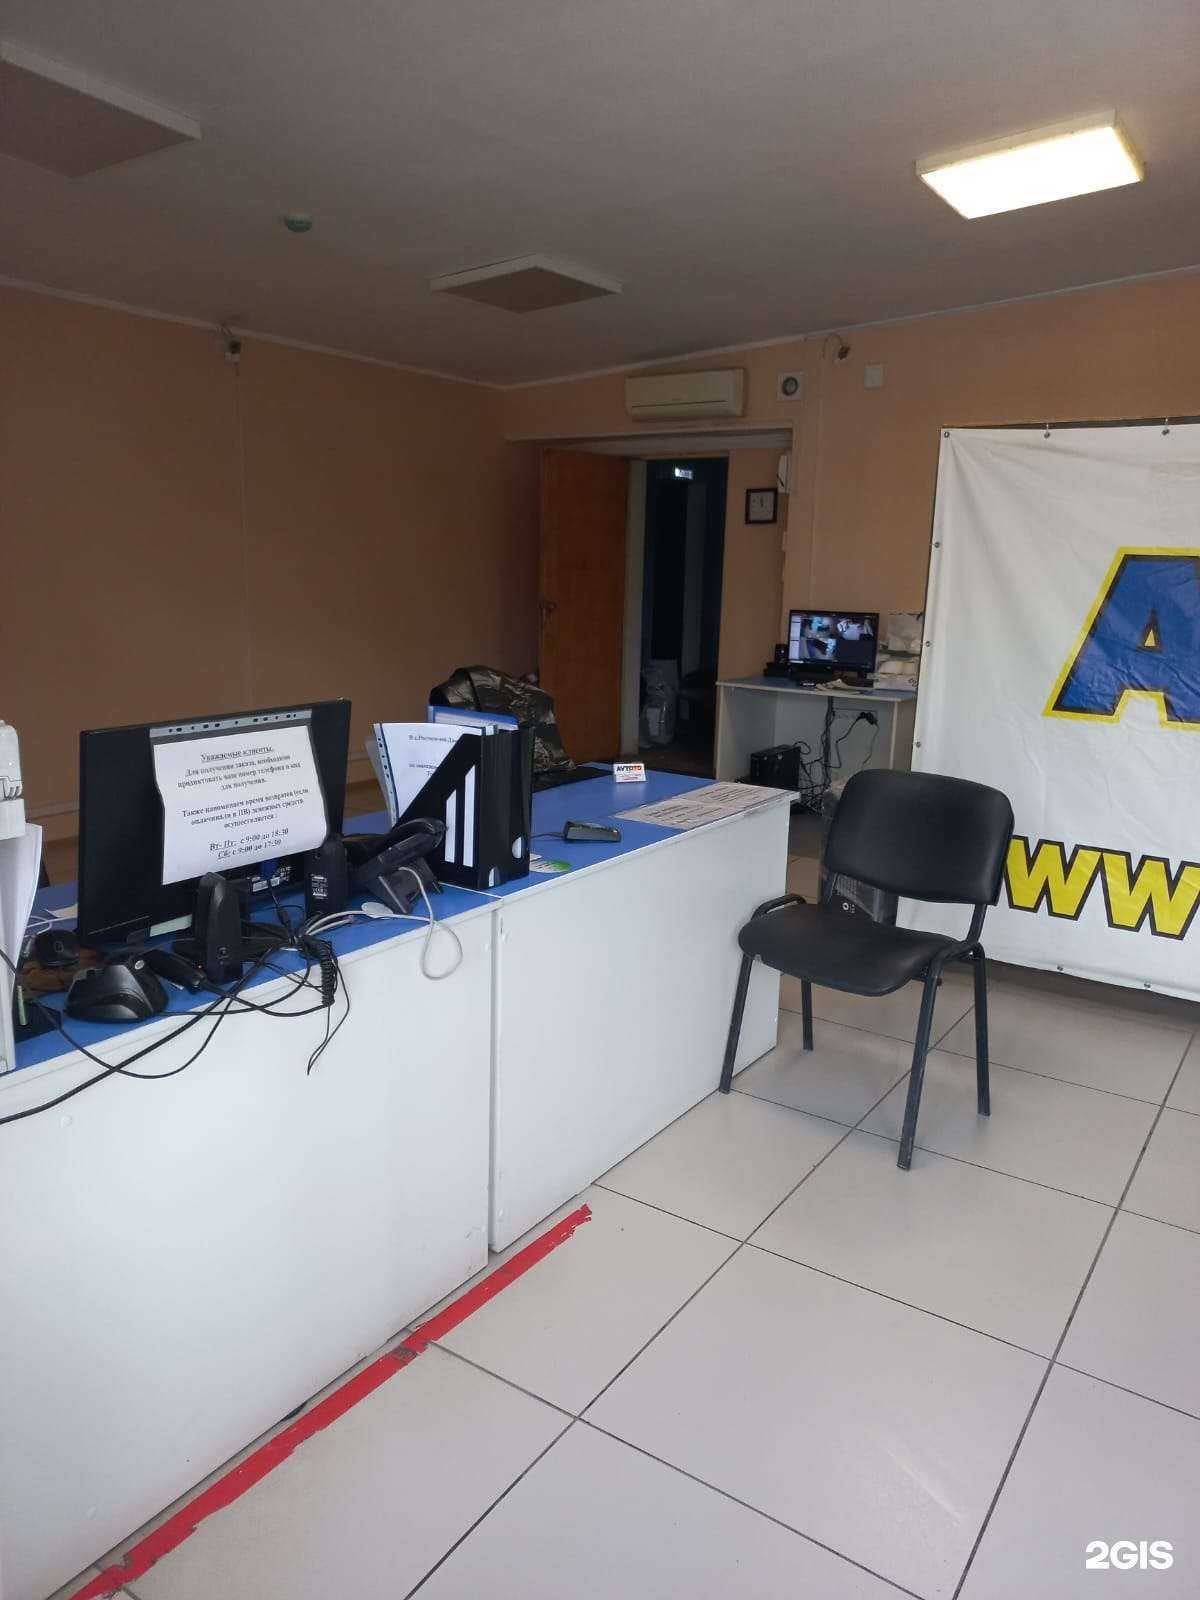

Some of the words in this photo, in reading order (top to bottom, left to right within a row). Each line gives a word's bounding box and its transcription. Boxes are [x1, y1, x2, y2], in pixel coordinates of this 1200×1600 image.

[200, 750, 242, 763] Уважаемые
[177, 776, 223, 789] продиктовать
[238, 770, 257, 779] номер
[257, 765, 285, 776] телефона
[185, 768, 199, 777] Для
[200, 764, 234, 775] получения
[182, 808, 205, 818] Также
[205, 801, 245, 814] напоминаем
[245, 797, 264, 807] время
[251, 803, 281, 814] денежных
[281, 798, 304, 809] средств
